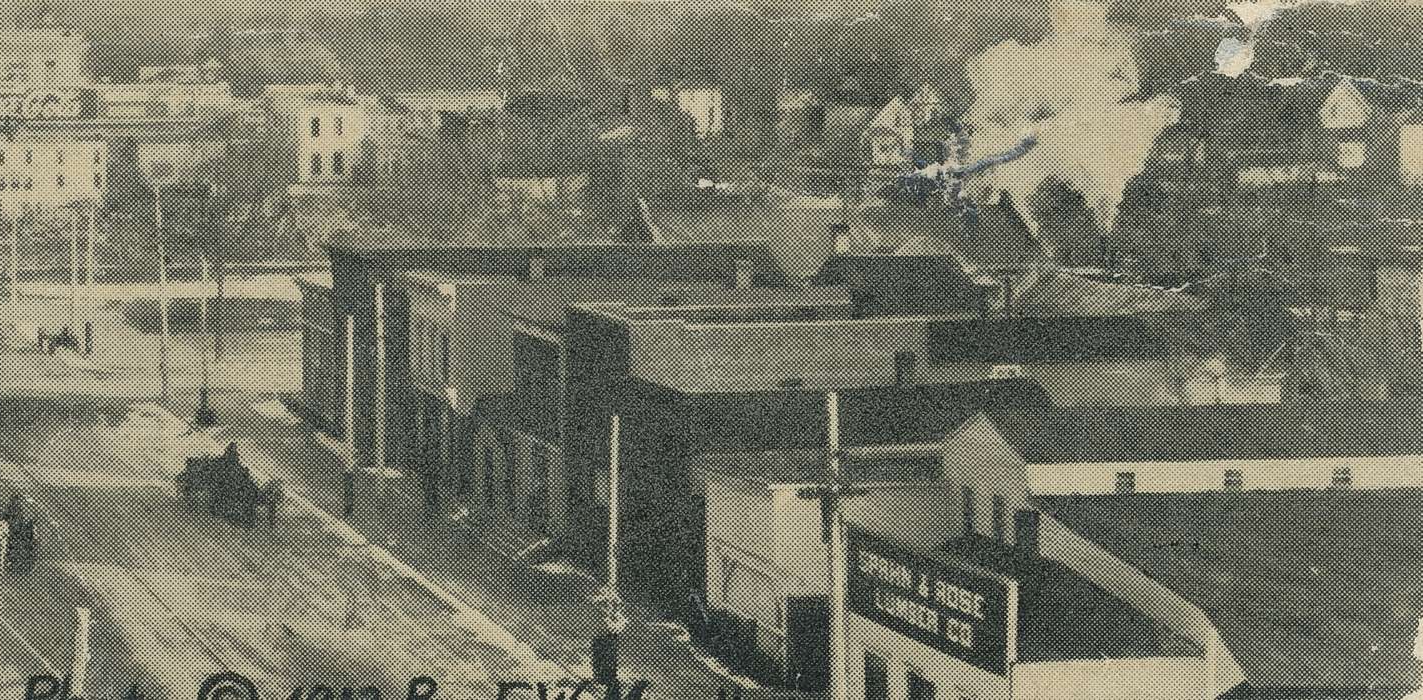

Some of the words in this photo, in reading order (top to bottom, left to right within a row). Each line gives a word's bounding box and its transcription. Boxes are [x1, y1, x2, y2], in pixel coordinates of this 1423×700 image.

[858, 549, 912, 590] SPAHN
[918, 574, 930, 599] &
[935, 578, 987, 622] ROSE
[875, 588, 940, 634] LUMBER
[947, 617, 973, 649] CO
